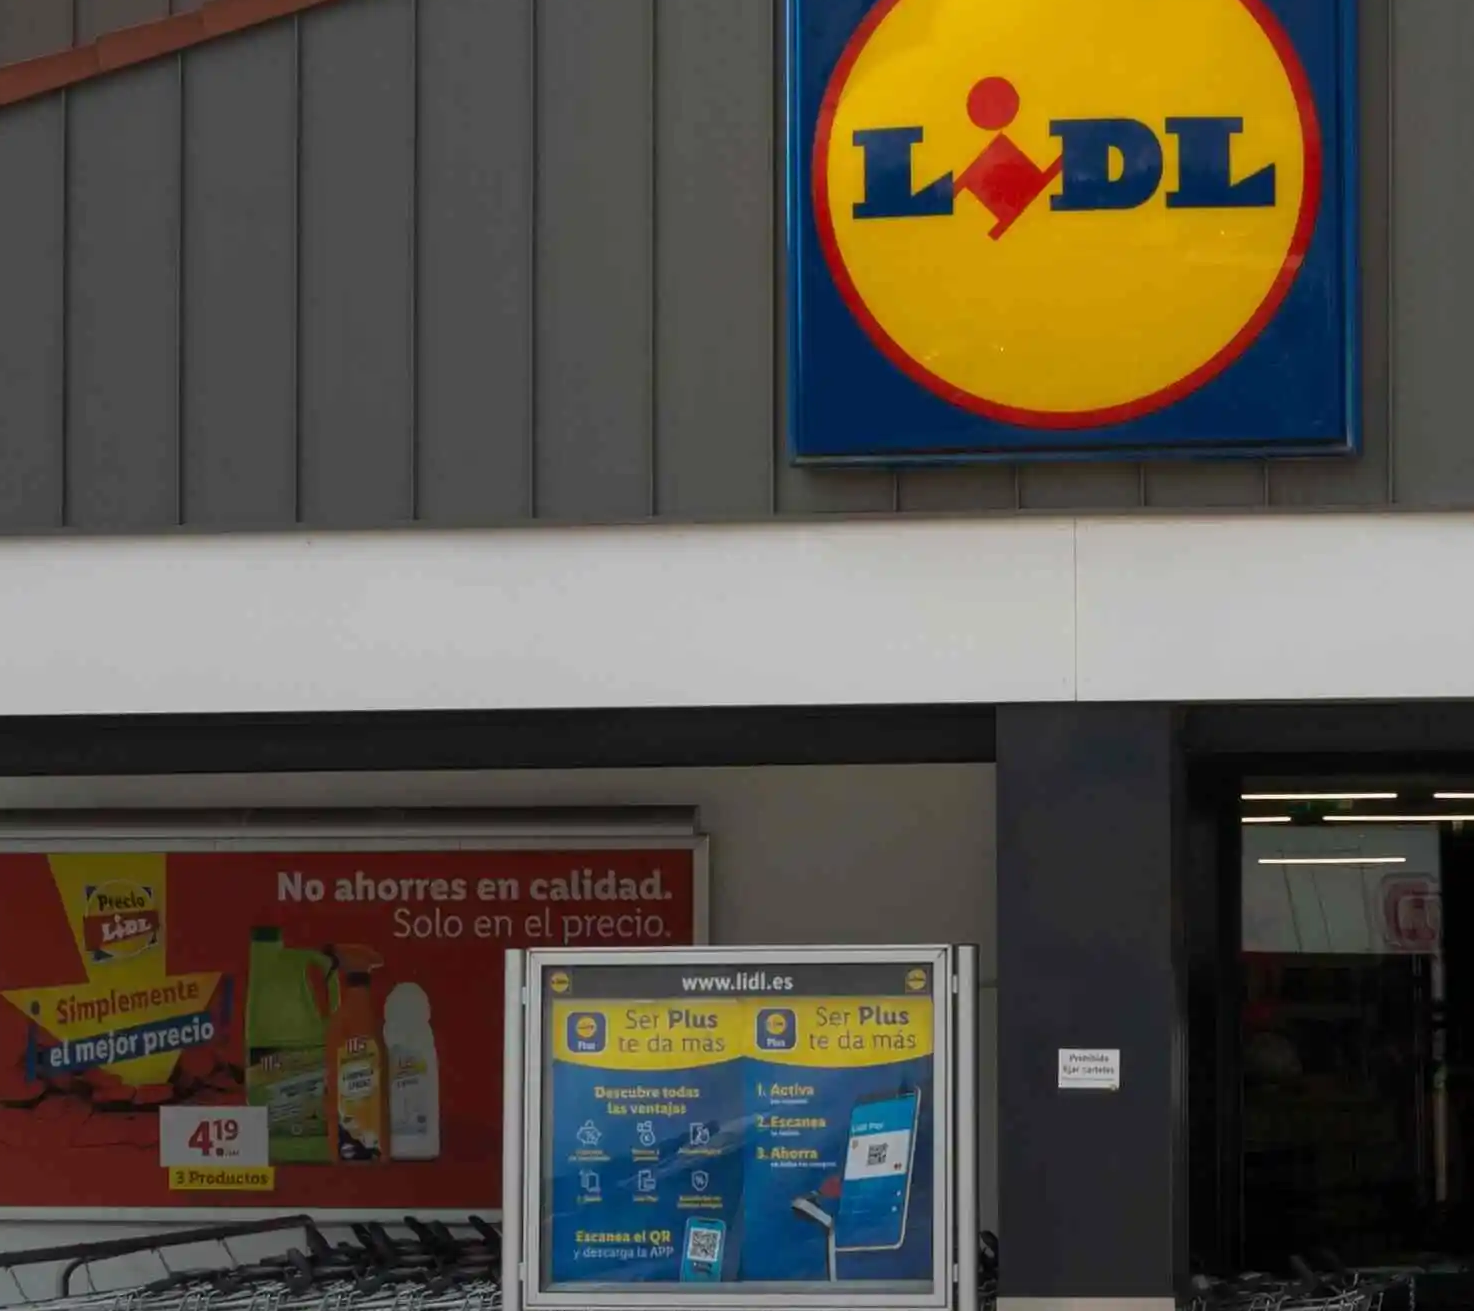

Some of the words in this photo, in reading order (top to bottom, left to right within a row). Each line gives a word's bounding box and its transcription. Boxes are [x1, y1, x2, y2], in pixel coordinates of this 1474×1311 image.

[852, 76, 1275, 241] LIDL
[277, 871, 323, 902] No
[334, 871, 467, 902] ahorres
[476, 877, 519, 901] en
[529, 869, 673, 902] calidad.
[97, 890, 146, 911] Precio
[393, 908, 463, 938] Solo
[474, 916, 512, 938] en
[524, 908, 553, 938] el
[563, 908, 672, 944] precio.
[682, 971, 794, 992] www.lidl.es
[57, 980, 199, 1025] Simplemente
[625, 1009, 660, 1030] Ser
[668, 1008, 718, 1029] Plus
[816, 1006, 851, 1026] Ser
[858, 1005, 910, 1026] Plus
[49, 1045, 70, 1067] el
[75, 1032, 138, 1065] mejor
[143, 1017, 215, 1055] precio
[618, 1034, 638, 1052] te
[648, 1033, 672, 1053] da
[809, 1031, 829, 1050] te
[838, 1030, 863, 1050] da
[872, 1029, 917, 1050] más
[594, 1086, 660, 1099] Descubre
[662, 1086, 699, 1099] todas
[770, 1082, 814, 1097] Activa
[607, 1102, 627, 1115] las
[630, 1102, 686, 1117] ventajas
[770, 1115, 827, 1128] Escanea
[770, 1146, 819, 1160] Ahorra
[175, 1171, 184, 1185] 3
[189, 1170, 268, 1185] Productos
[575, 1230, 630, 1242] Escanea
[633, 1230, 646, 1242] el
[649, 1230, 671, 1245] QR
[582, 1246, 634, 1260] descarga
[637, 1246, 647, 1257] la
[649, 1246, 674, 1257] APP
